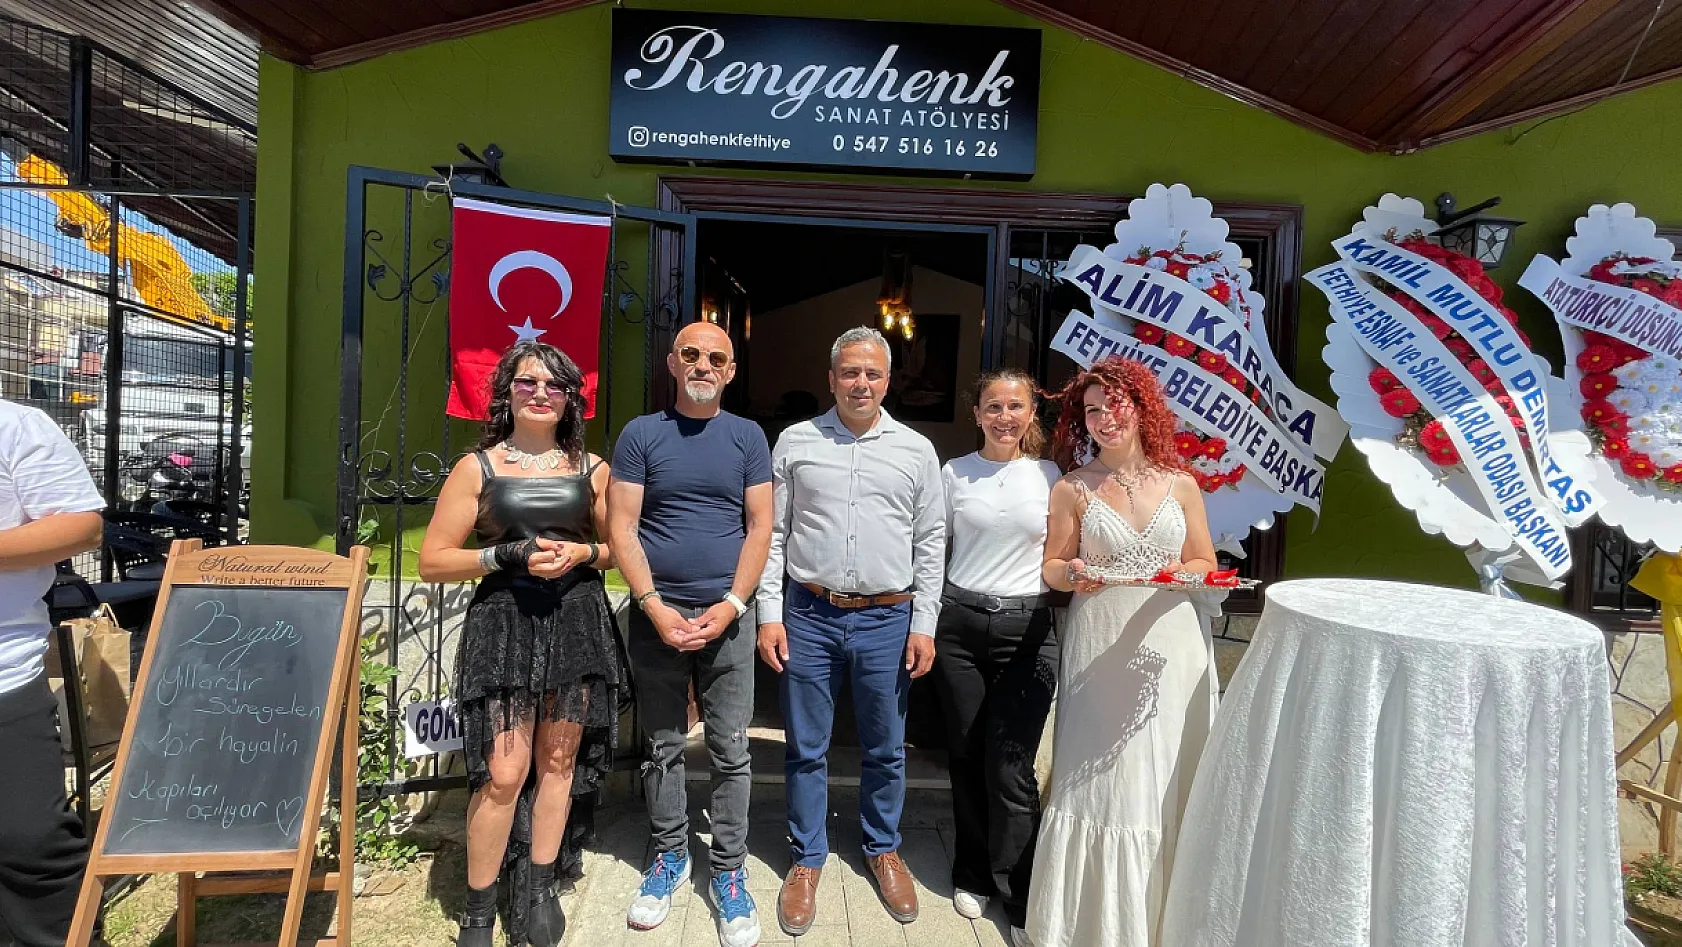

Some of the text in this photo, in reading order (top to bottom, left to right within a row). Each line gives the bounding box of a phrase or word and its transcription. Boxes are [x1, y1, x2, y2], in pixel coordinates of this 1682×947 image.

[624, 25, 1014, 119] Rengahenk
[652, 130, 791, 150] rengahenkfethiye
[815, 105, 1009, 131] SANAT ATÖLYESİ
[832, 134, 998, 157] 0 547 516 16 26
[1317, 267, 1376, 320] FETHİYE
[1342, 237, 1431, 289] KAMİL
[1425, 283, 1522, 367] MUTLU
[1355, 309, 1417, 352] ESNAF
[1076, 263, 1317, 446] ALİM KARACA
[1391, 344, 1421, 365] ve
[1163, 366, 1268, 458] BELEDİYE
[1482, 452, 1527, 505] ODASI
[1504, 498, 1571, 569] BAŞKANI
[198, 554, 333, 575] Natural wind
[201, 574, 326, 586] Write a better future
[158, 722, 298, 764] bir hayalin
[415, 700, 464, 745] GÖK
